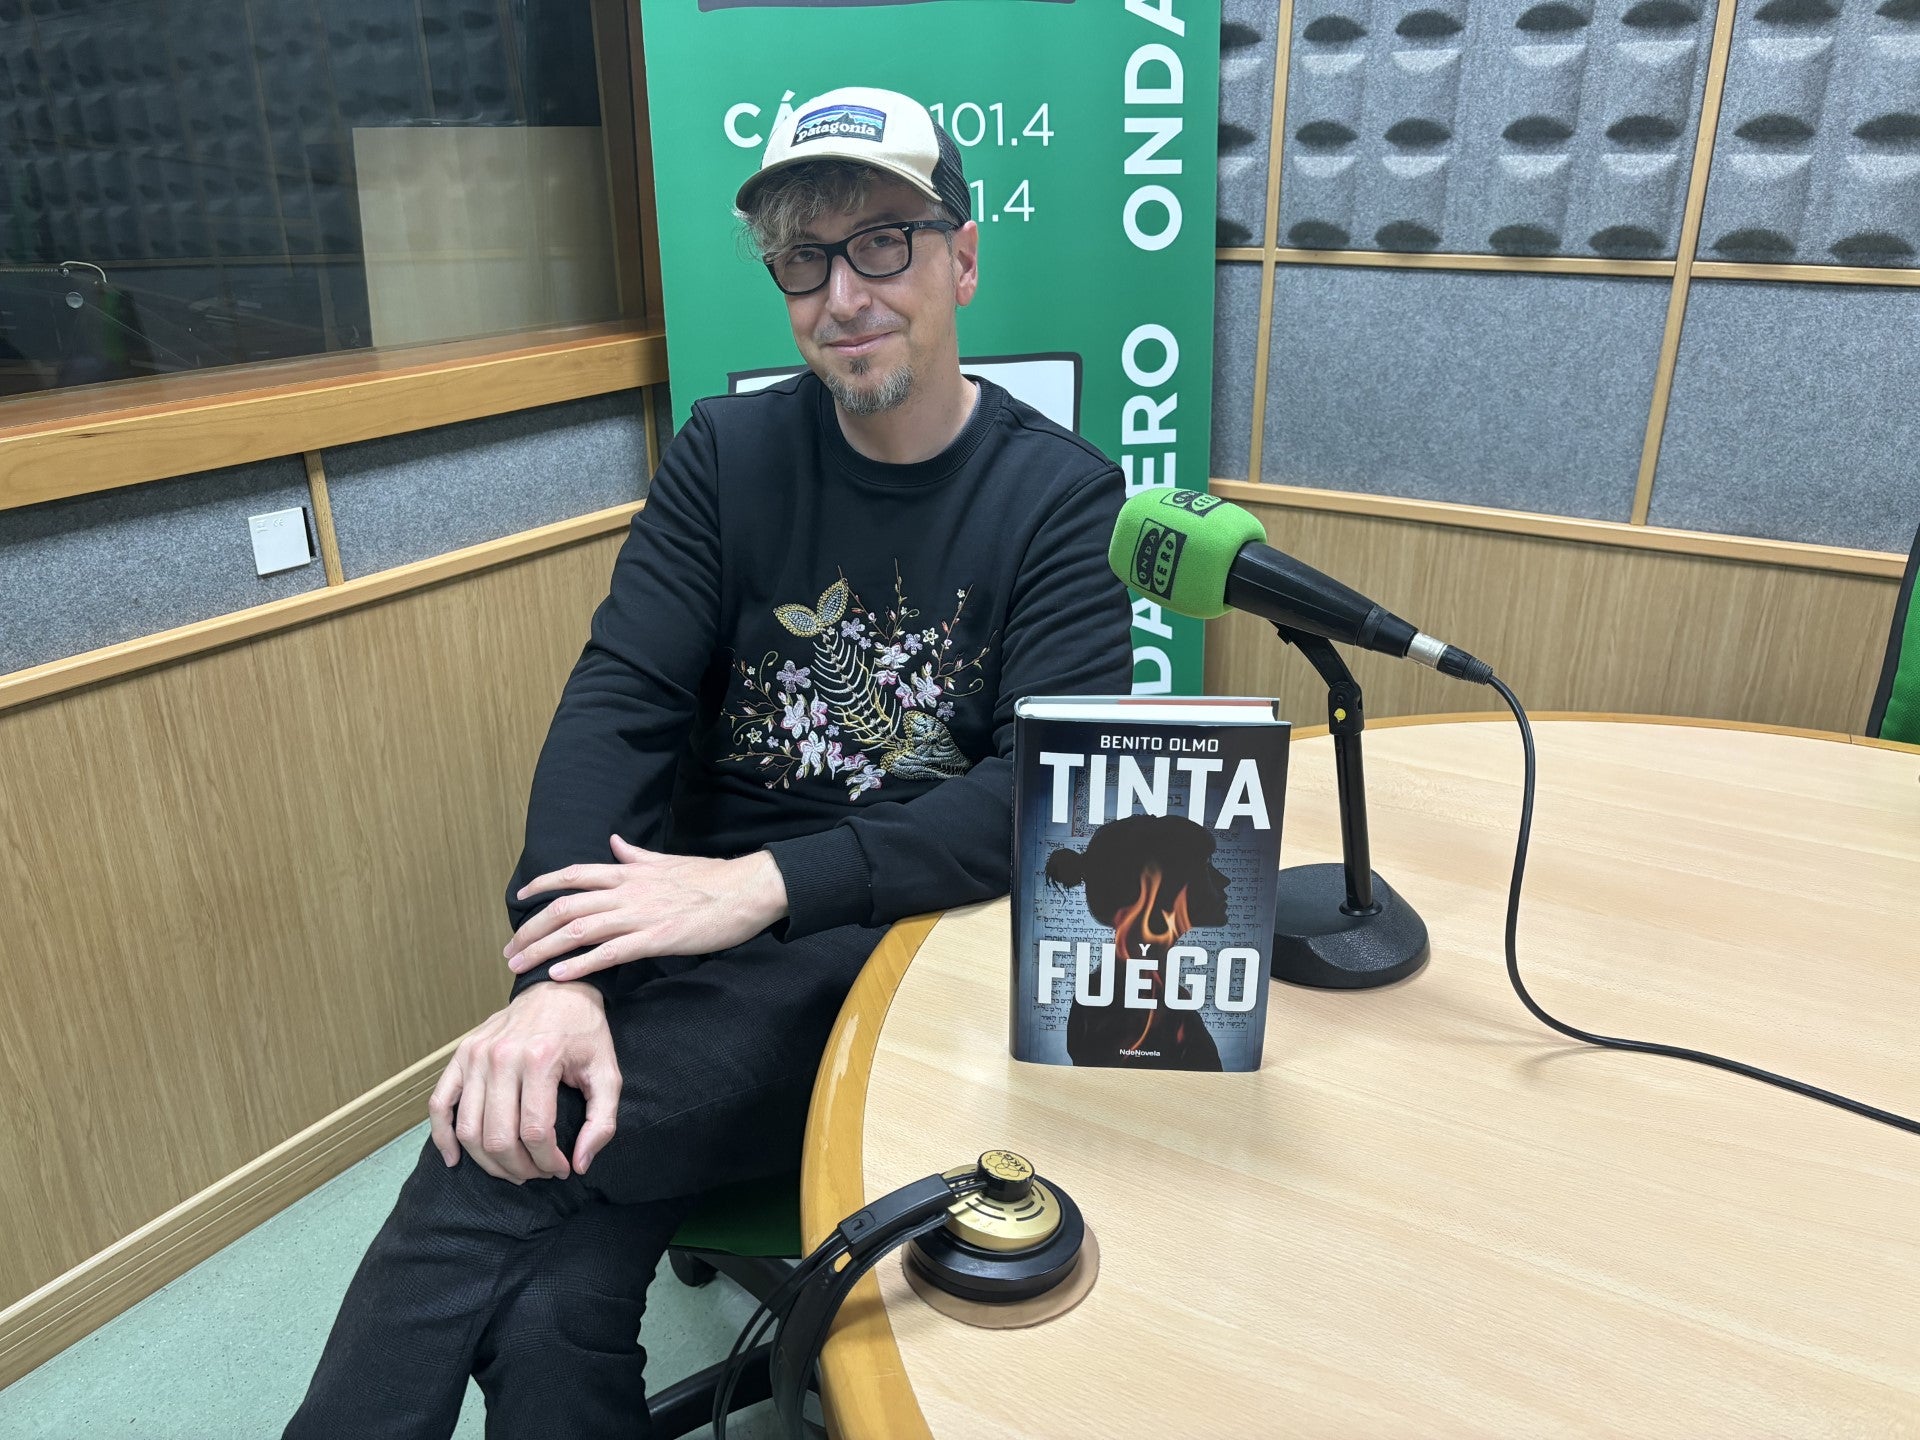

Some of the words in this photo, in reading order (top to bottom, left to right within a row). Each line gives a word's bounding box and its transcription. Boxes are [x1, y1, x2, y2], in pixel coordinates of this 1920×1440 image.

[795, 121, 876, 143] patagonia
[1121, 323, 1180, 502] ERO
[1139, 534, 1156, 580] ONDA
[1155, 538, 1176, 587] CERO
[1100, 735, 1162, 751] BENITO
[1169, 738, 1219, 753] OLMO
[1039, 752, 1271, 830] TINTA
[1138, 943, 1151, 957] Y
[1037, 940, 1261, 1011] FUEGO
[1119, 1049, 1161, 1057] NdeNovela
